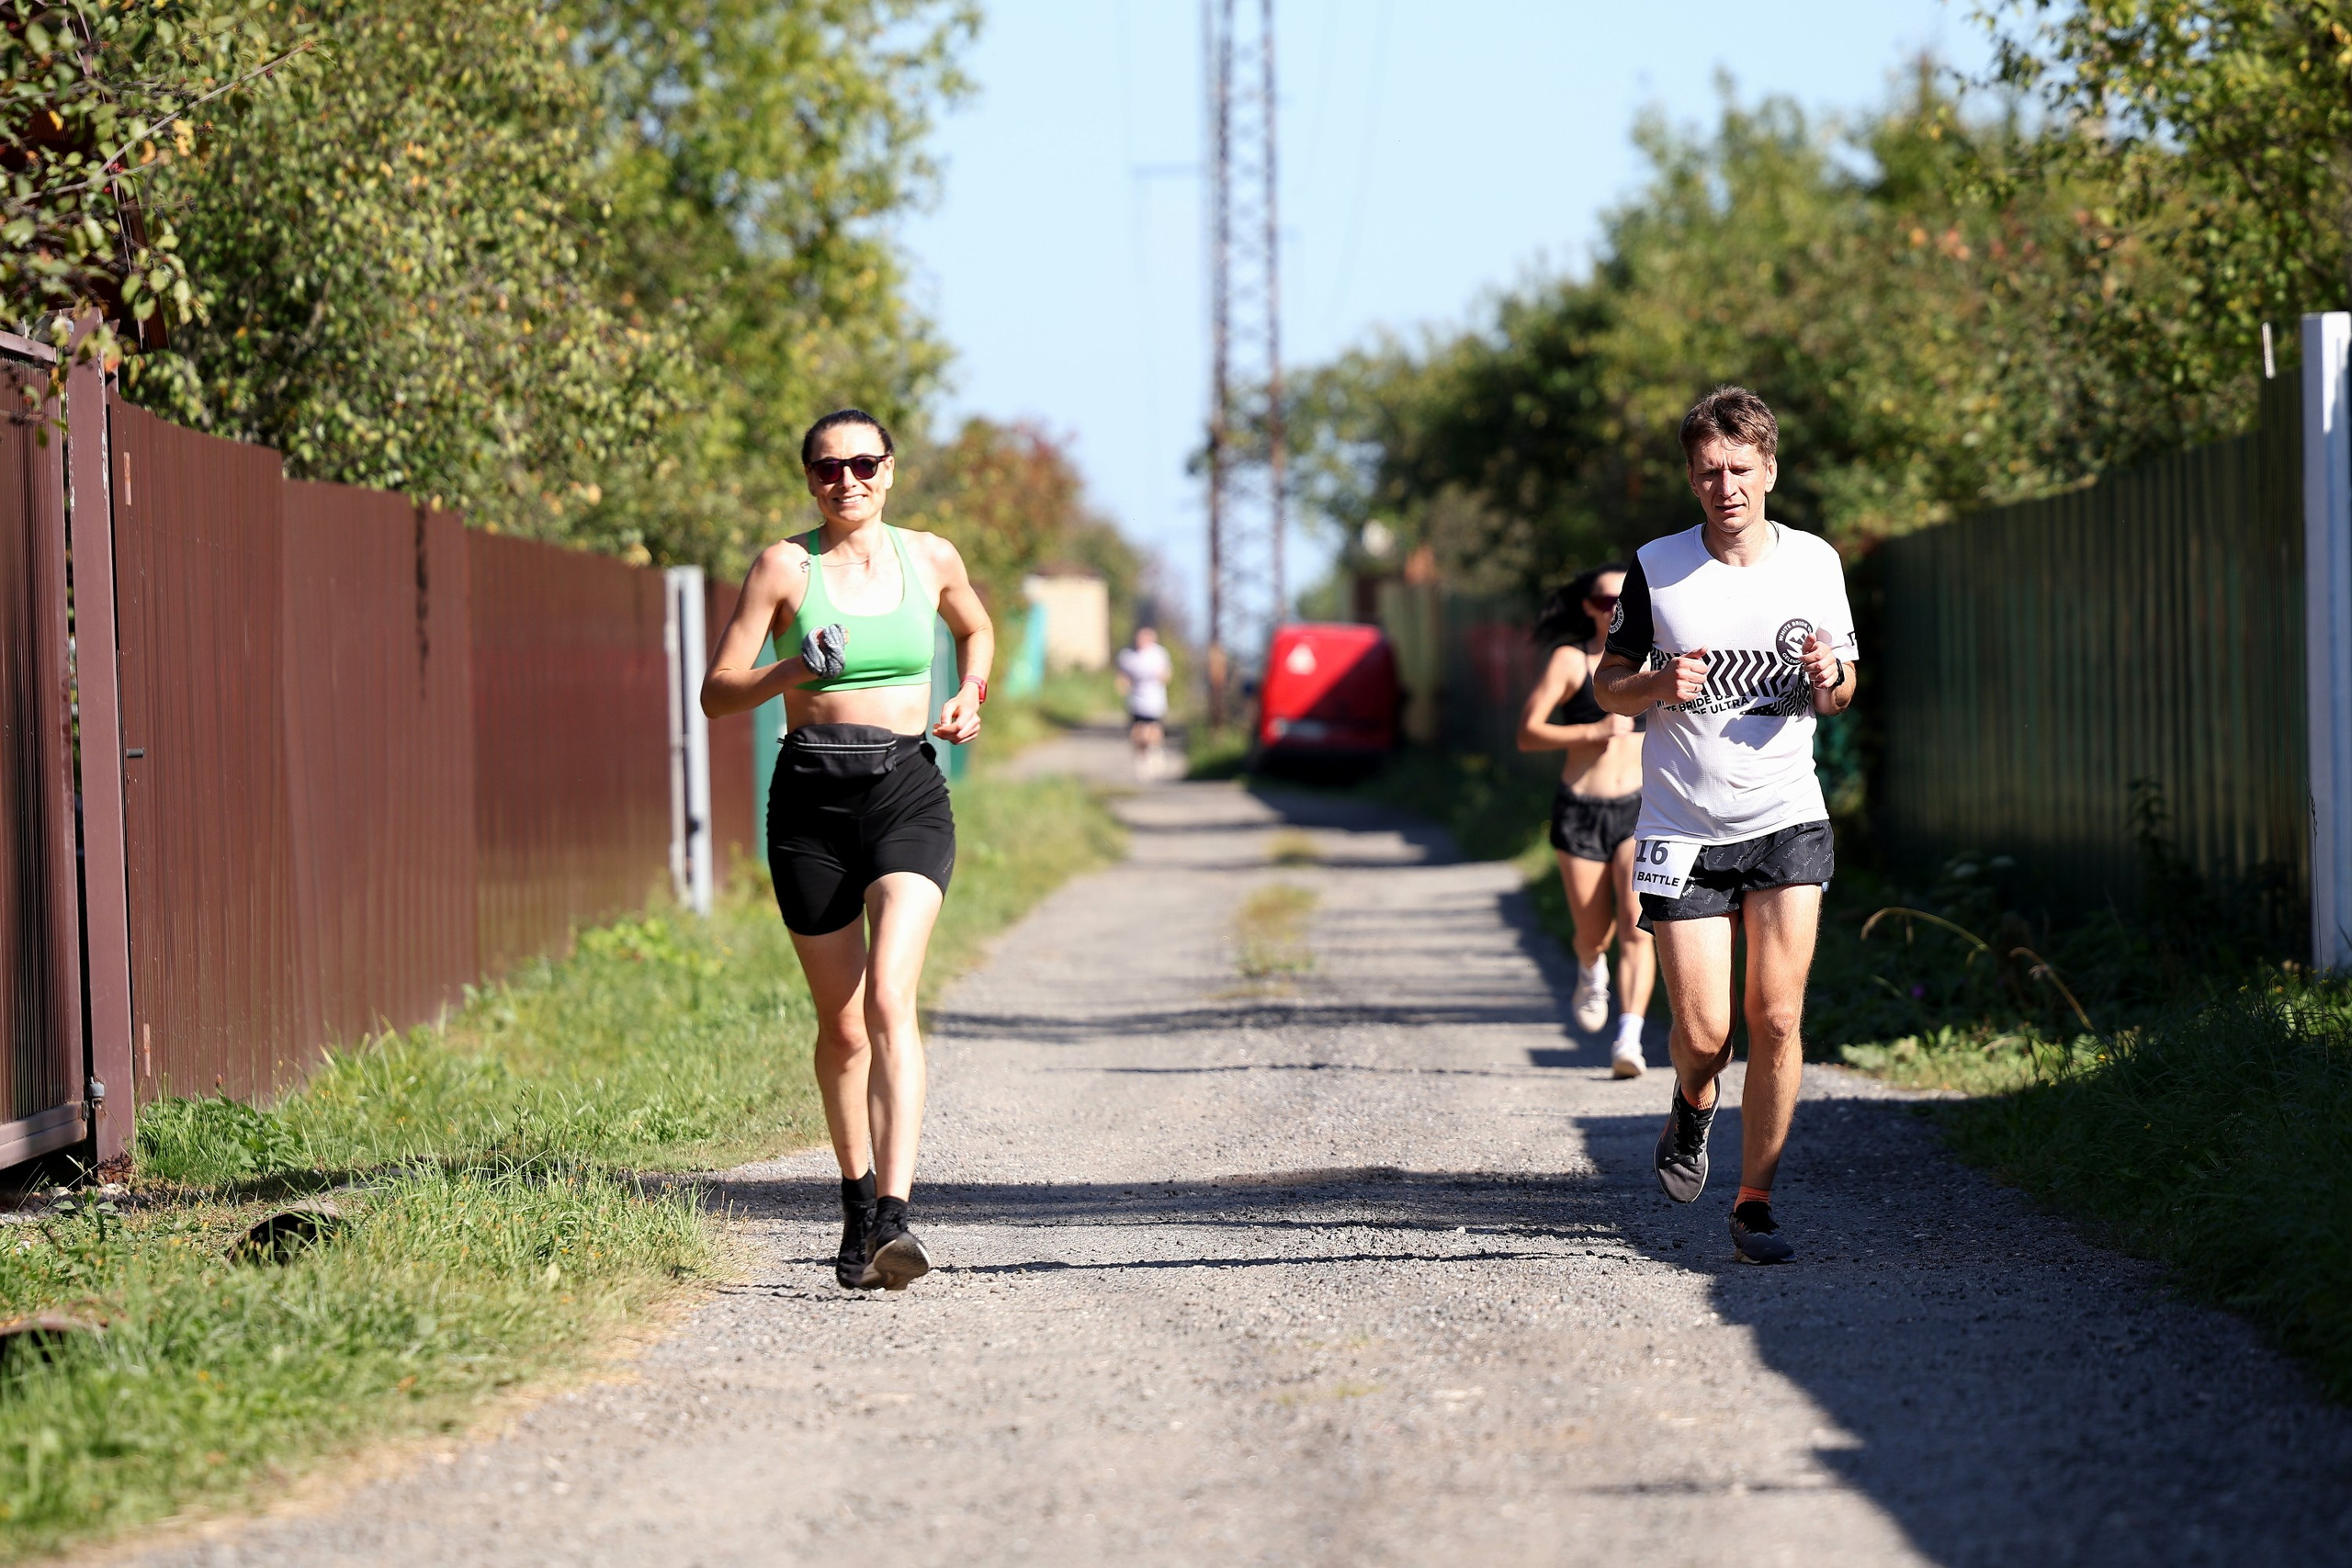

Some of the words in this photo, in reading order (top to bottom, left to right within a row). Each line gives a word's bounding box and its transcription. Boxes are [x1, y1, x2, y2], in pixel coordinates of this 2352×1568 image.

[1779, 624, 1792, 641] WHITE
[1679, 695, 1712, 712] BRIDE
[1710, 696, 1750, 714] ULTRA
[1636, 840, 1669, 864] 16
[1637, 871, 1680, 886] BATTLE
